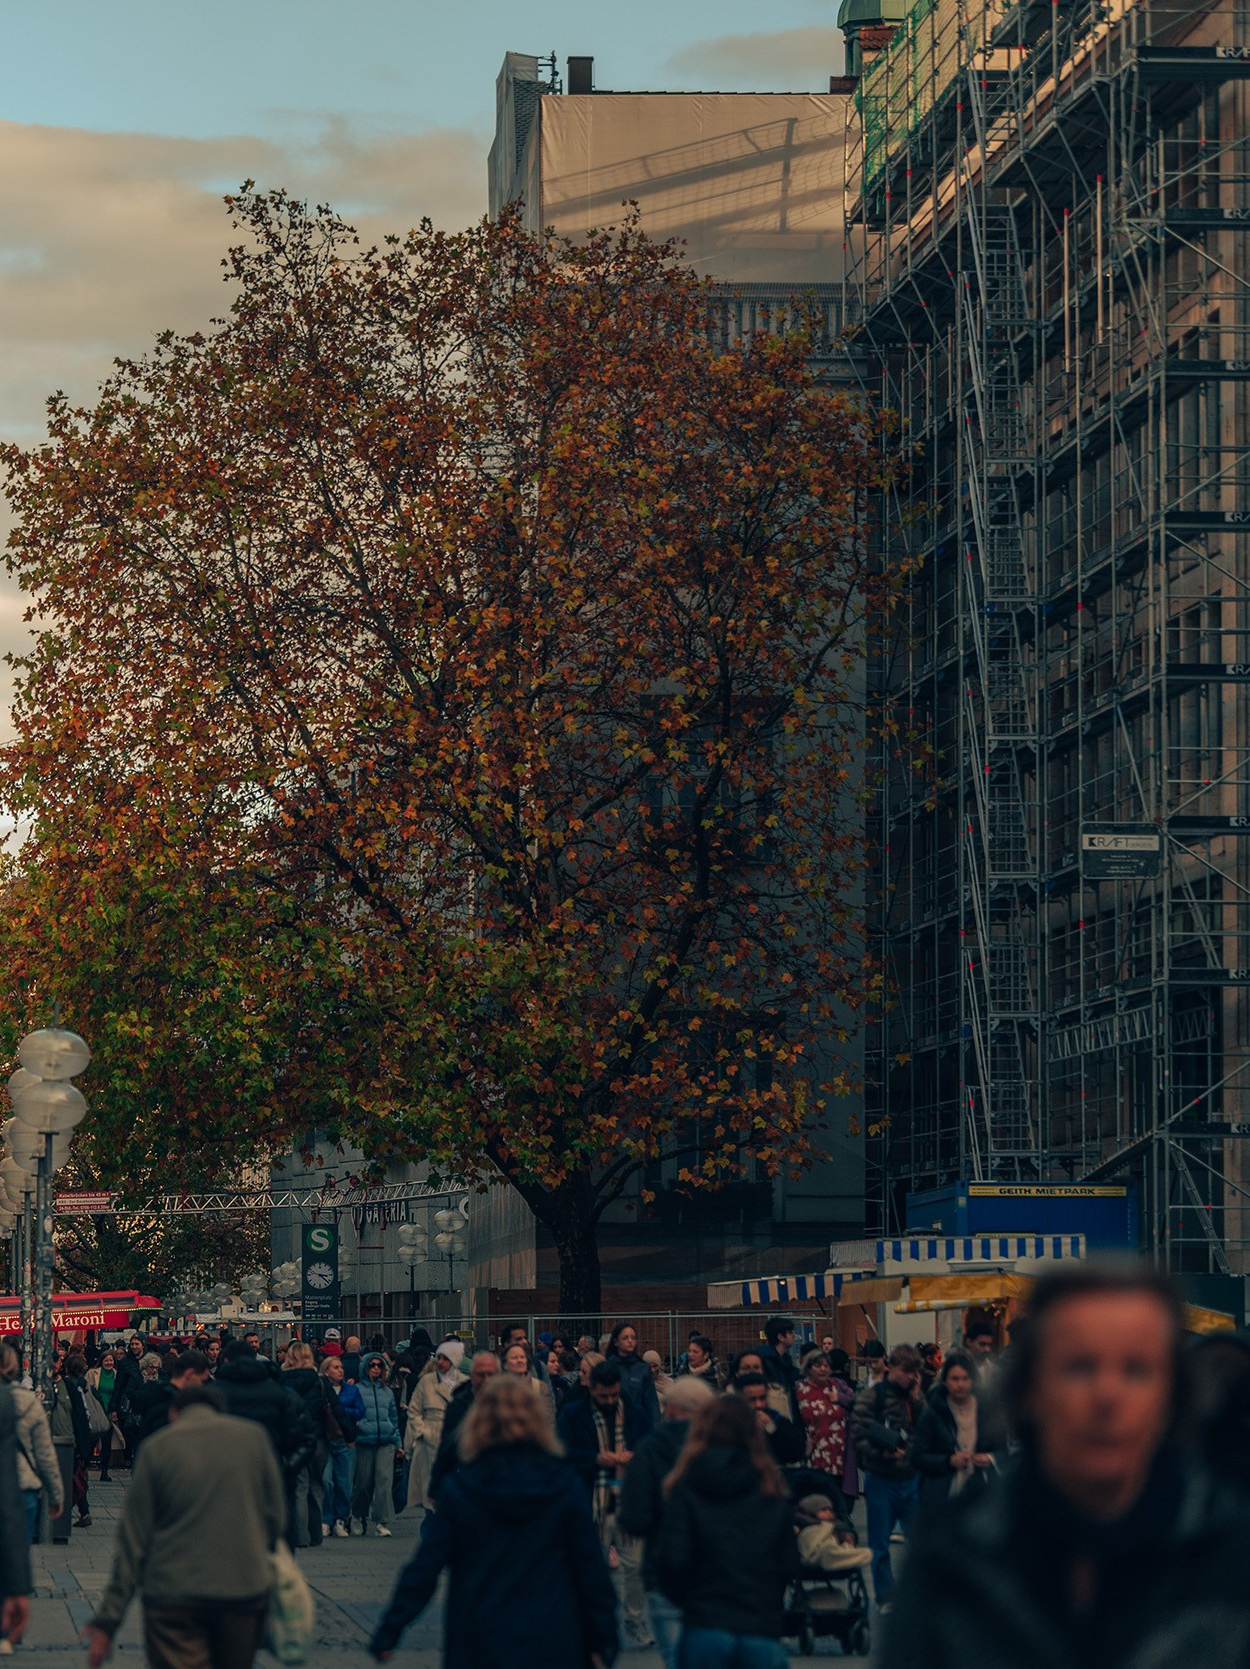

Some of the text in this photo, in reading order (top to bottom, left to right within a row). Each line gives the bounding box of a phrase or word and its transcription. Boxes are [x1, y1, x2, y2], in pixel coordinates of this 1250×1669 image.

[999, 1187, 1032, 1195] GEITH
[1035, 1187, 1095, 1195] MIETPARK
[366, 1201, 406, 1223] GAERIA
[311, 1228, 329, 1252] S
[50, 1311, 105, 1328] Maroni
